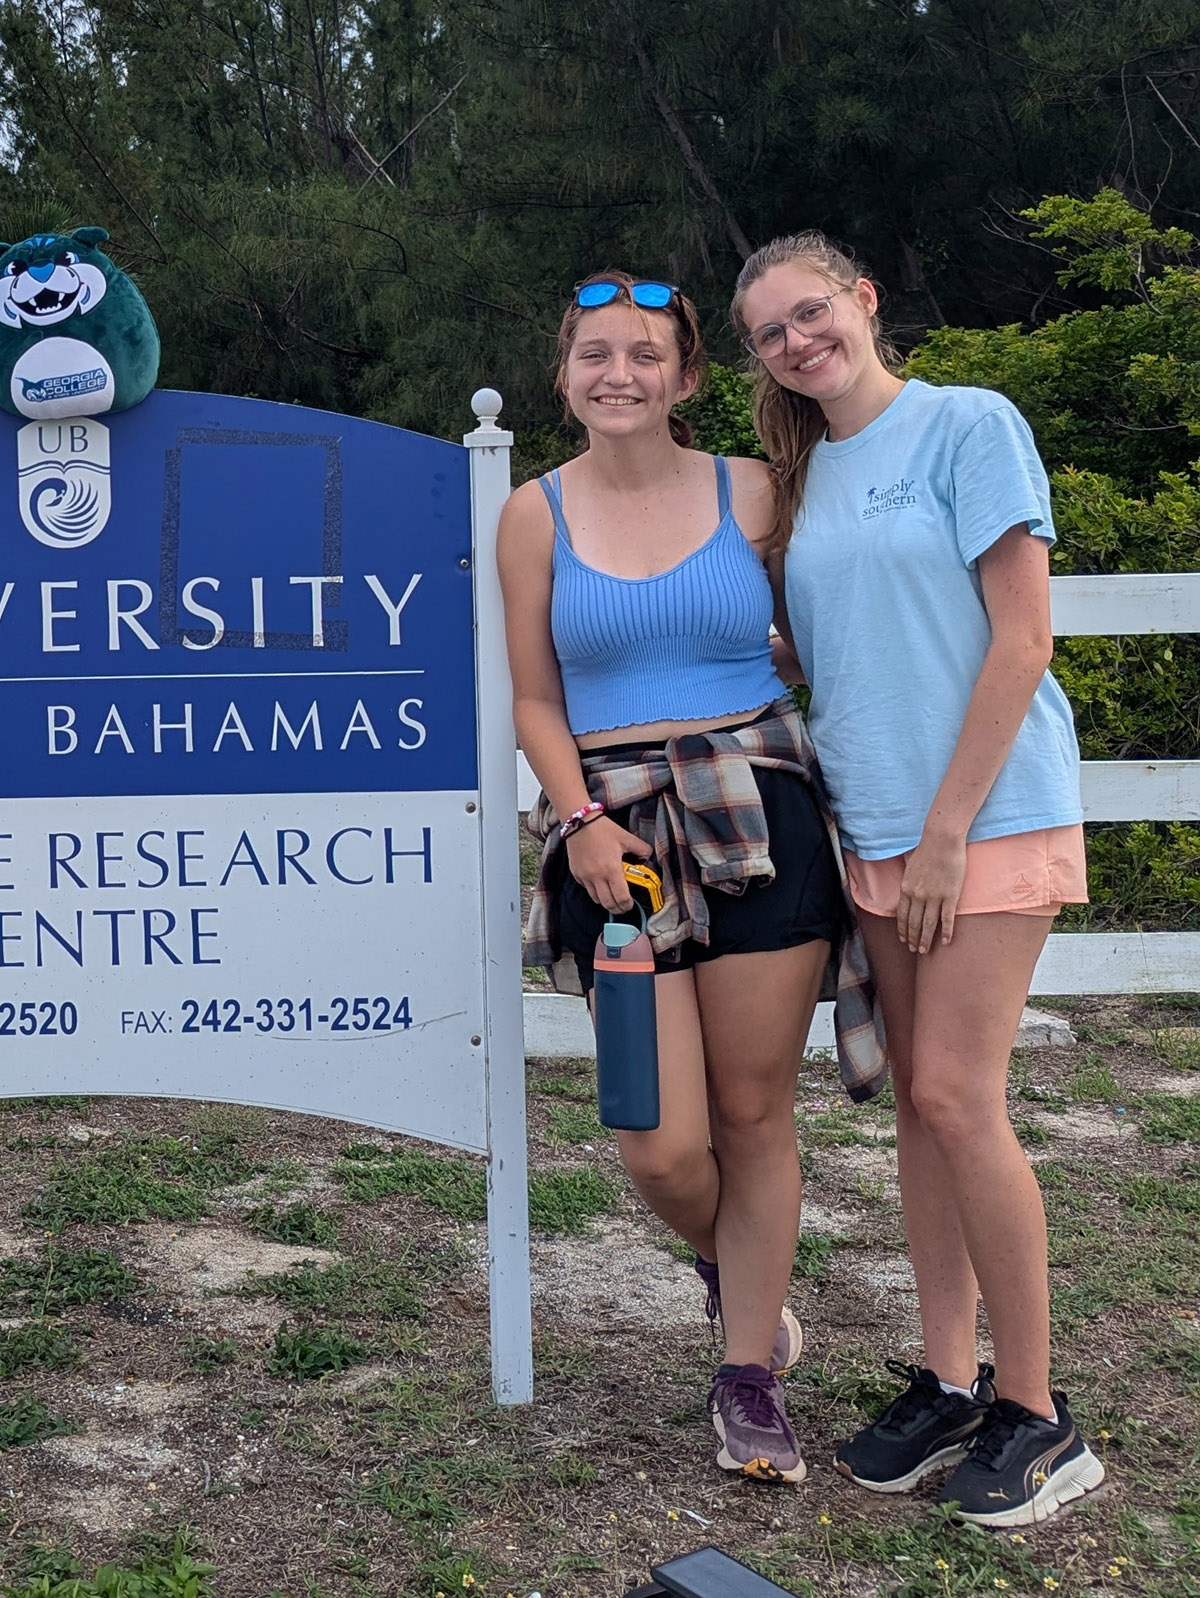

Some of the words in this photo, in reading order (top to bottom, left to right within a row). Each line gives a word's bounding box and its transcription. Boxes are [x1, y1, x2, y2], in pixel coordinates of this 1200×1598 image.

[44, 369, 104, 388] GEORGIA
[45, 377, 106, 396] COLLEGE
[38, 424, 88, 454] UB
[873, 478, 912, 502] simply
[47, 698, 426, 755] BAHAMAS
[48, 826, 433, 889] RESEARCH
[120, 1010, 174, 1035] FAX:
[181, 996, 413, 1034] 242-331-2524
